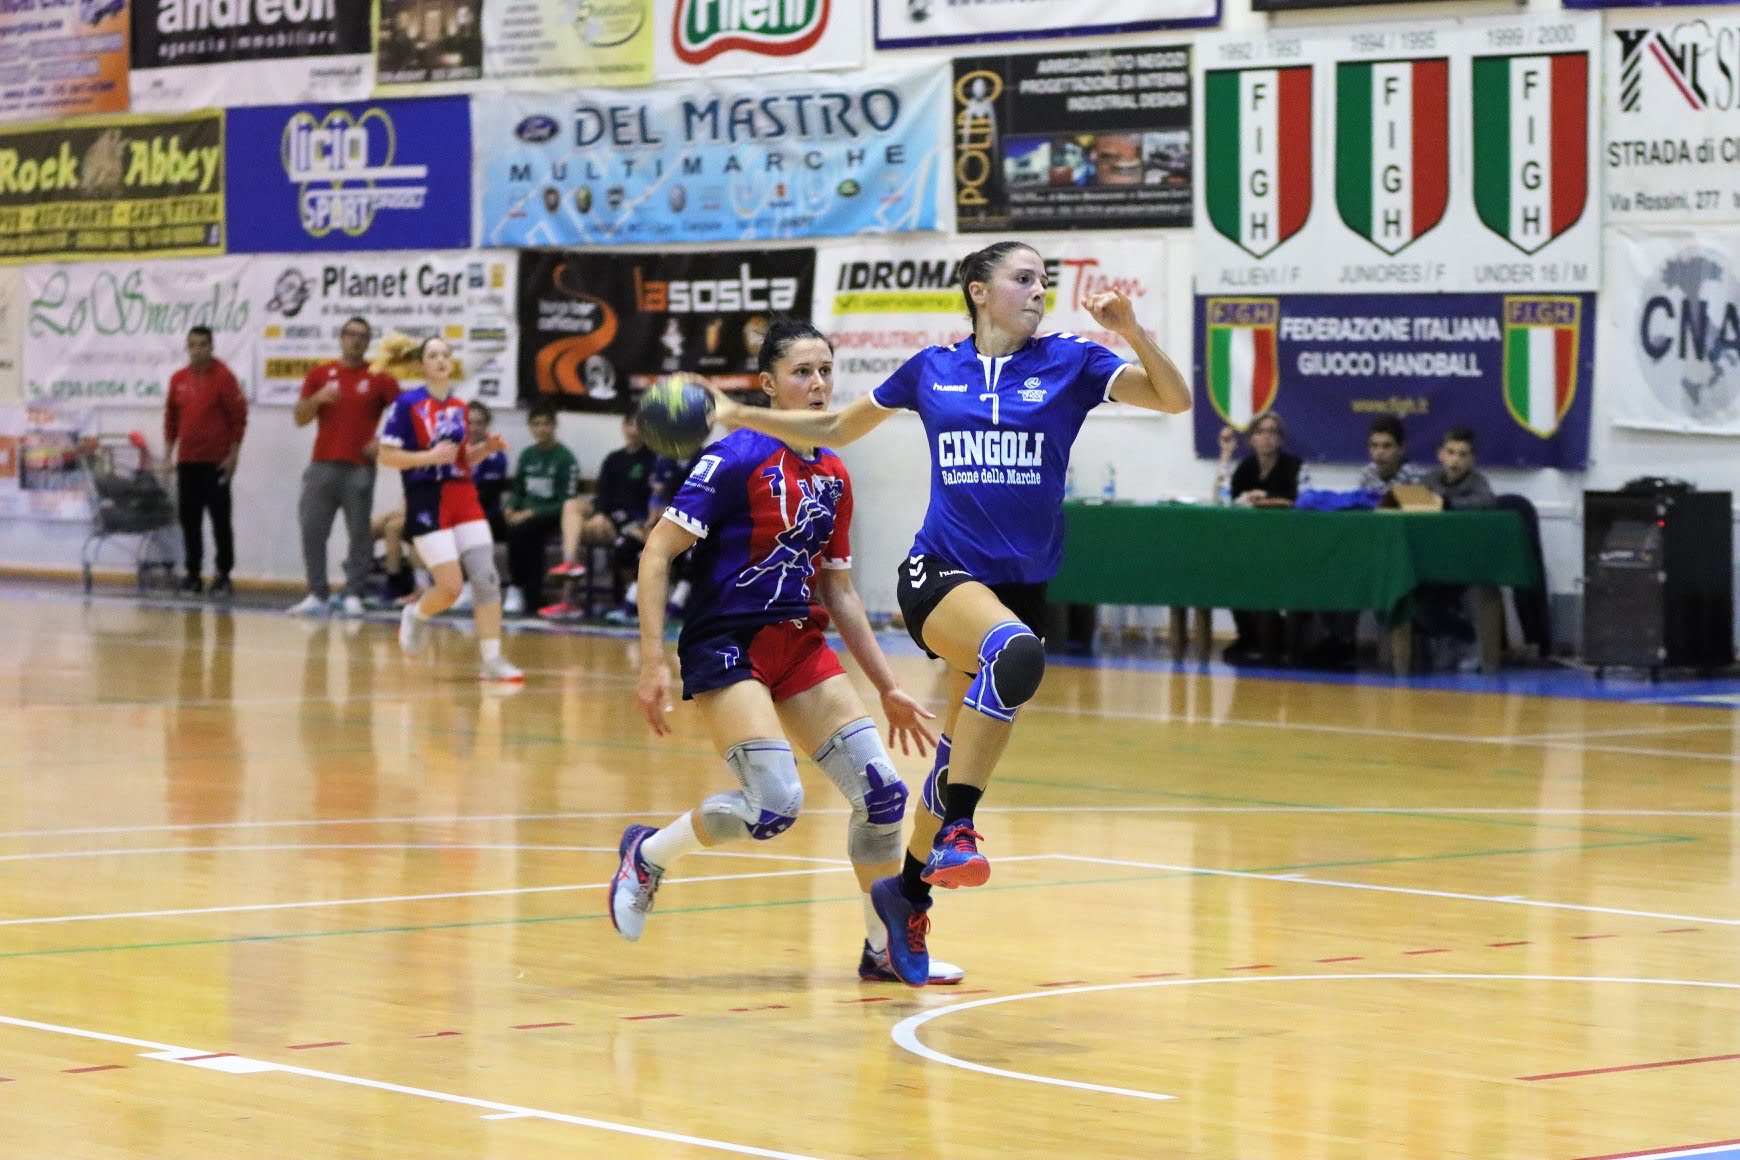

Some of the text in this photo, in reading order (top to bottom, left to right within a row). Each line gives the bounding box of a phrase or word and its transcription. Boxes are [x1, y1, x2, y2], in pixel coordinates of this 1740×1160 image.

[158, 31, 336, 58] agenzia immobiliare
[1351, 33, 1385, 51] 1994
[1401, 31, 1437, 49] 1995
[1488, 27, 1524, 45] 1999
[1538, 24, 1576, 44] 2000
[574, 88, 900, 147] DEL MASTRO
[0, 134, 220, 194] Rock Abbey
[508, 144, 906, 181] MULTIMARCHE
[1250, 83, 1269, 240] FIGH
[1382, 76, 1402, 238] FIGH
[1521, 70, 1542, 236] FIGH
[1608, 136, 1740, 168] STRADA di C
[1609, 193, 1631, 211] Via
[1696, 190, 1720, 209] 277
[323, 263, 463, 298] Planet Car
[1338, 265, 1421, 284] JUNIORES
[1474, 265, 1536, 283] UNDER
[1540, 264, 1558, 282] 16
[1572, 264, 1588, 282] M
[1279, 316, 1501, 342] FEDERAZIONE ITALIANA
[1297, 351, 1483, 377] GIUOCO HANDBALL
[933, 382, 968, 393] hummel
[979, 392, 1000, 425] 7
[938, 430, 1045, 467] CINGOLI
[941, 468, 1041, 486] Balcone delle Marche
